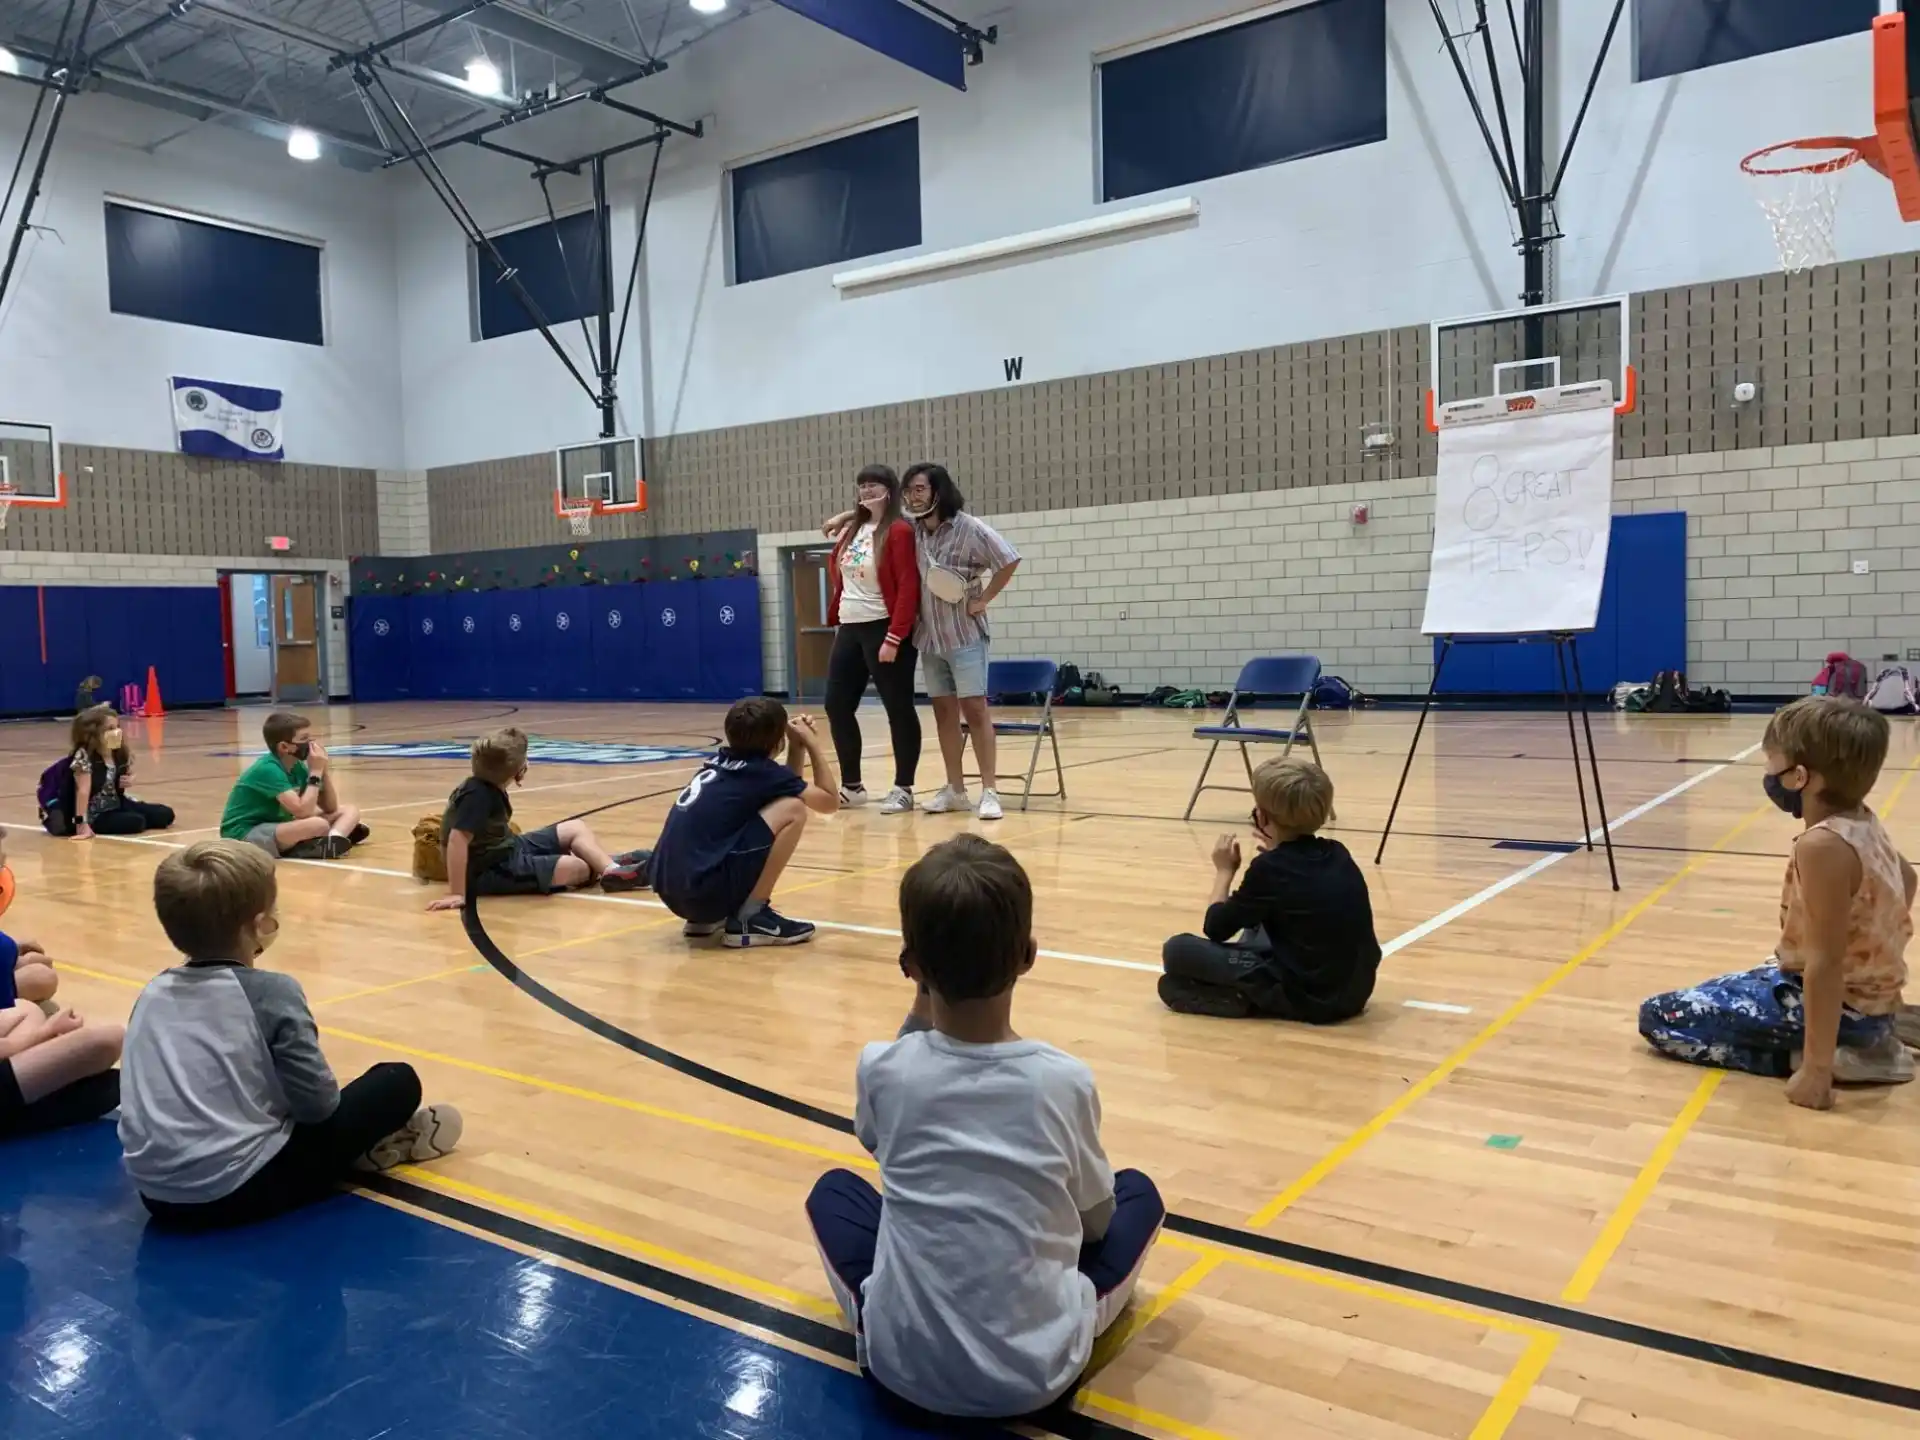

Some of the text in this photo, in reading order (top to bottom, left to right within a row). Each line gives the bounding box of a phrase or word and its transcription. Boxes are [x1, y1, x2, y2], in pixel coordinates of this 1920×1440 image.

[1004, 357, 1023, 381] W
[1463, 454, 1588, 531] 8 GREAT
[1454, 527, 1595, 576] TIPS!
[676, 768, 718, 807] 8
